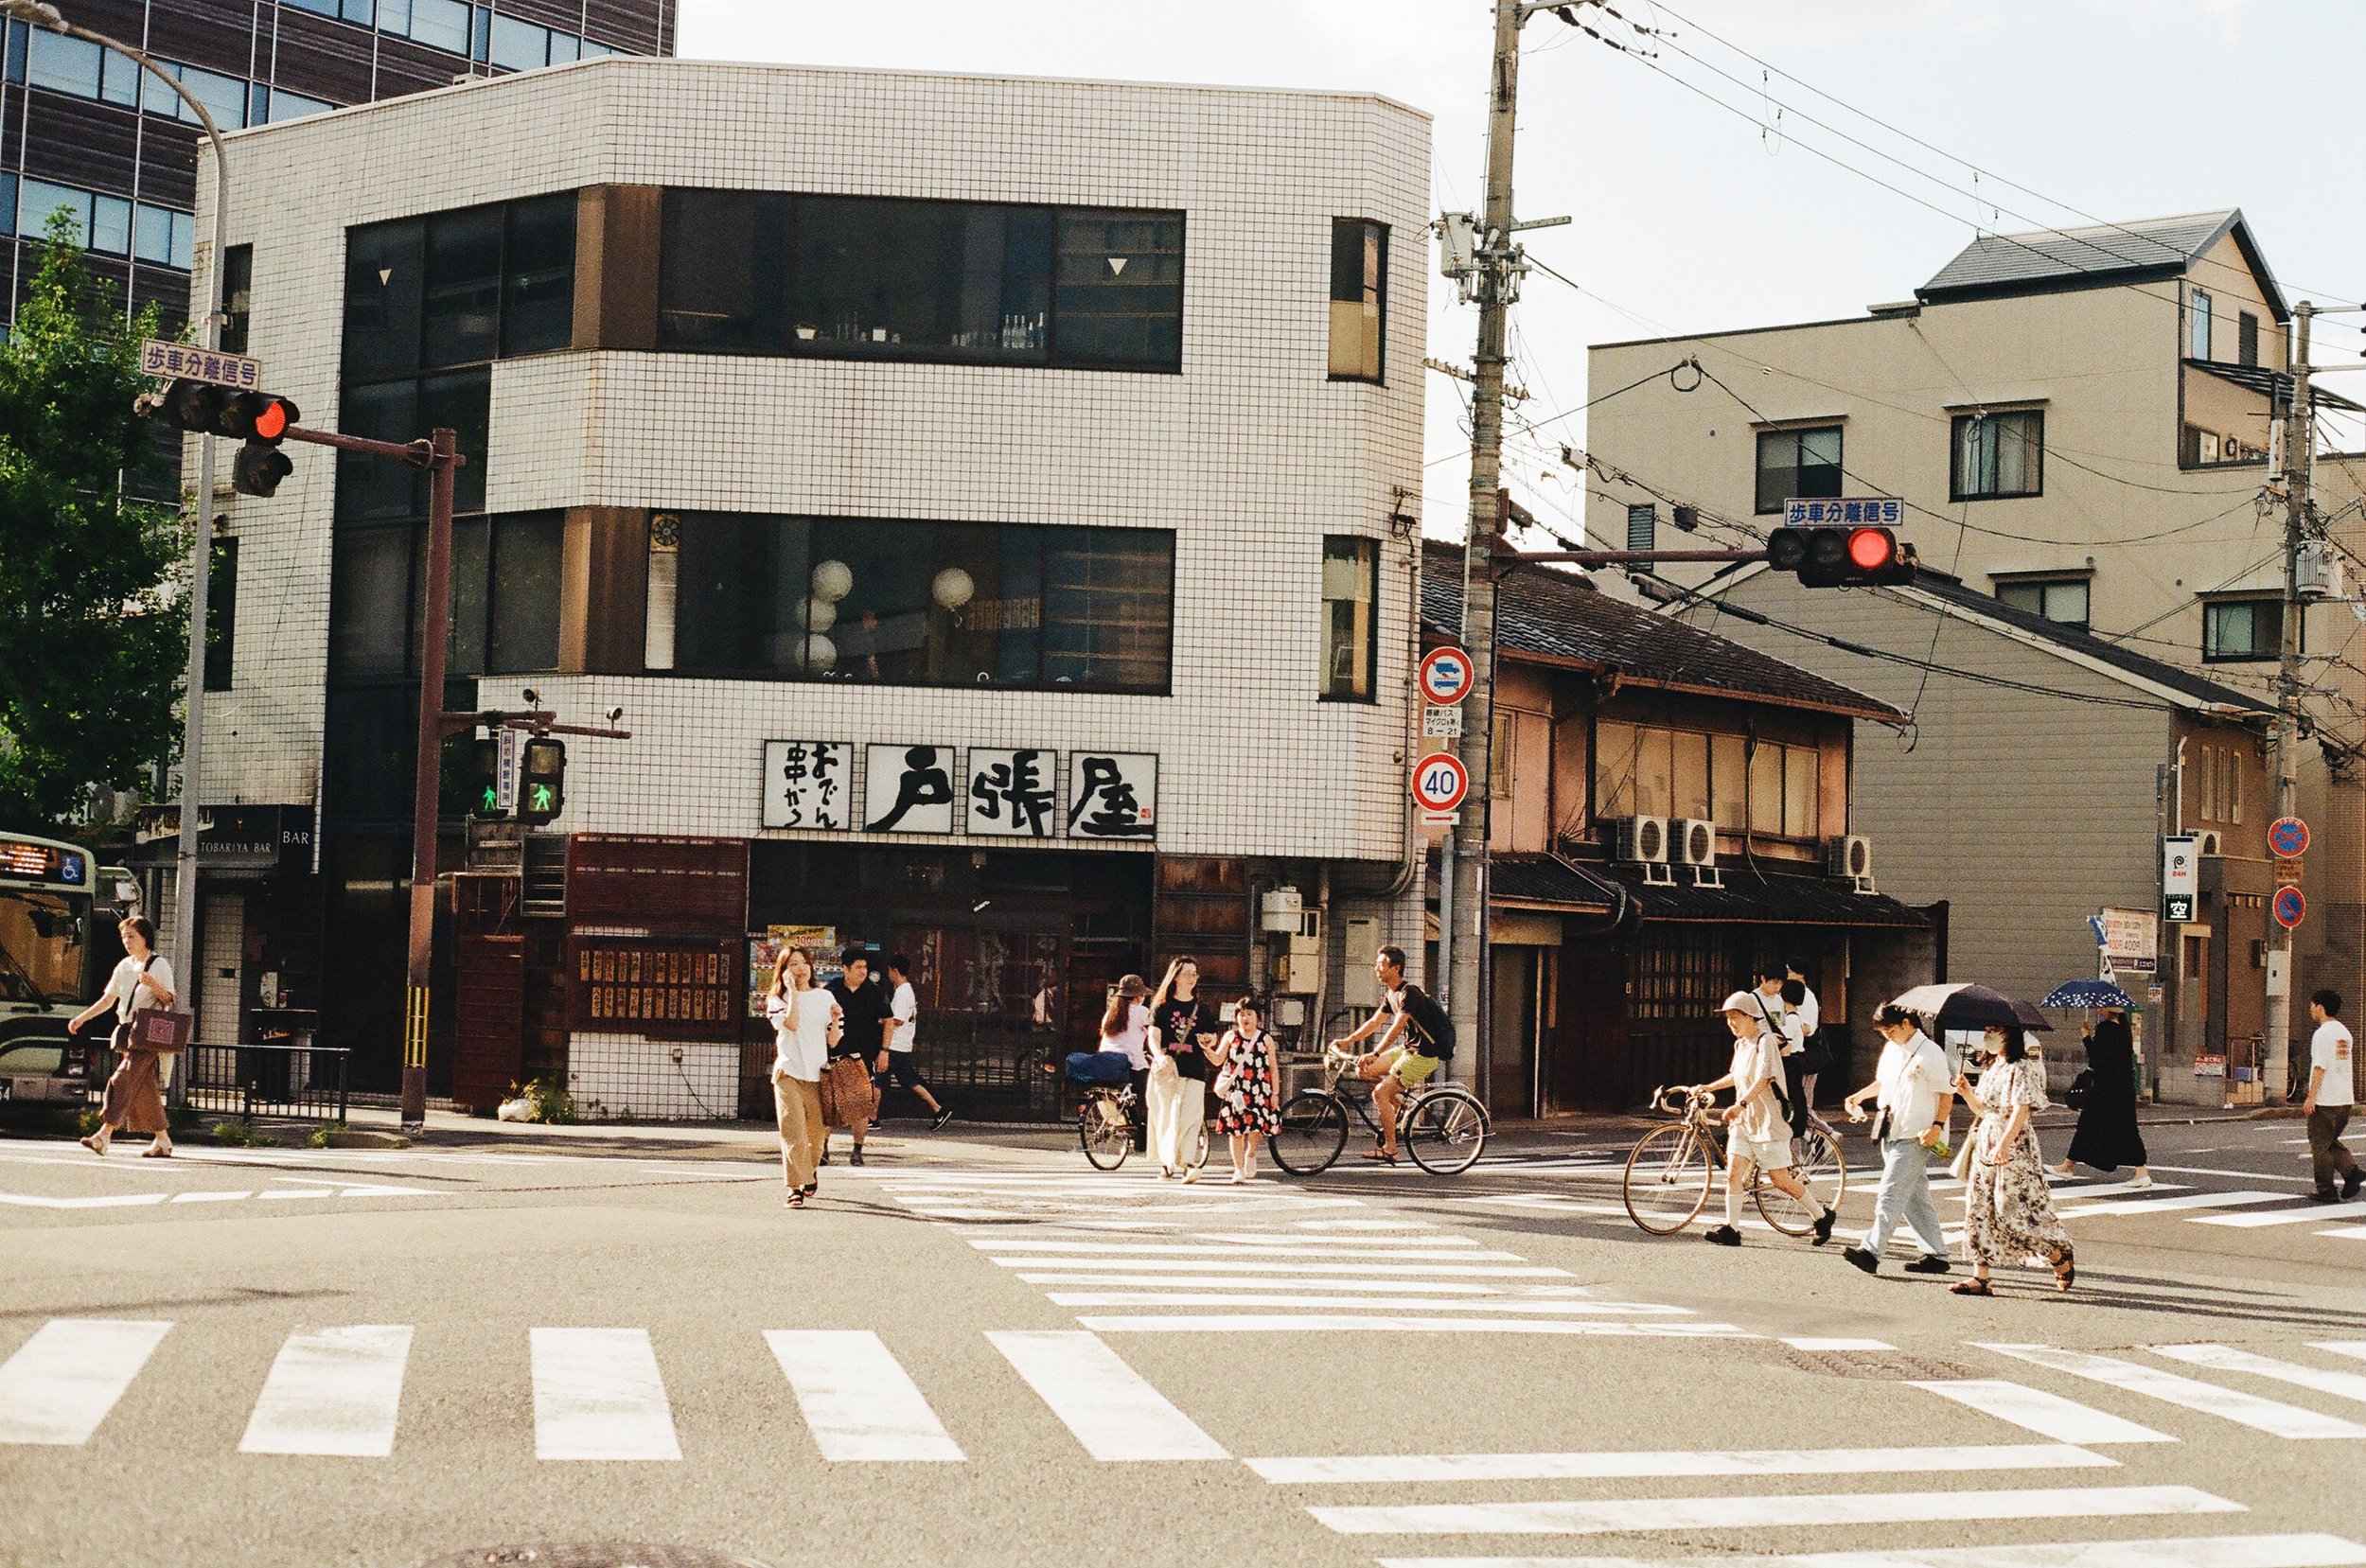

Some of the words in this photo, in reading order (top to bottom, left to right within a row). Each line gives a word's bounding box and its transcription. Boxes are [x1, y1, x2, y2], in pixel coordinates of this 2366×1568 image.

[147, 346, 256, 386] 歩車分離信号
[1790, 502, 1898, 522] 歩車分離信号
[784, 743, 807, 827] 串かつ
[811, 743, 839, 830] おでん
[865, 746, 1154, 837] 戸張屋
[1424, 770, 1455, 795] 40
[201, 842, 248, 853] TOBARIYA
[254, 842, 271, 853] BAR
[282, 831, 309, 845] BAR
[2170, 901, 2188, 919] 空
